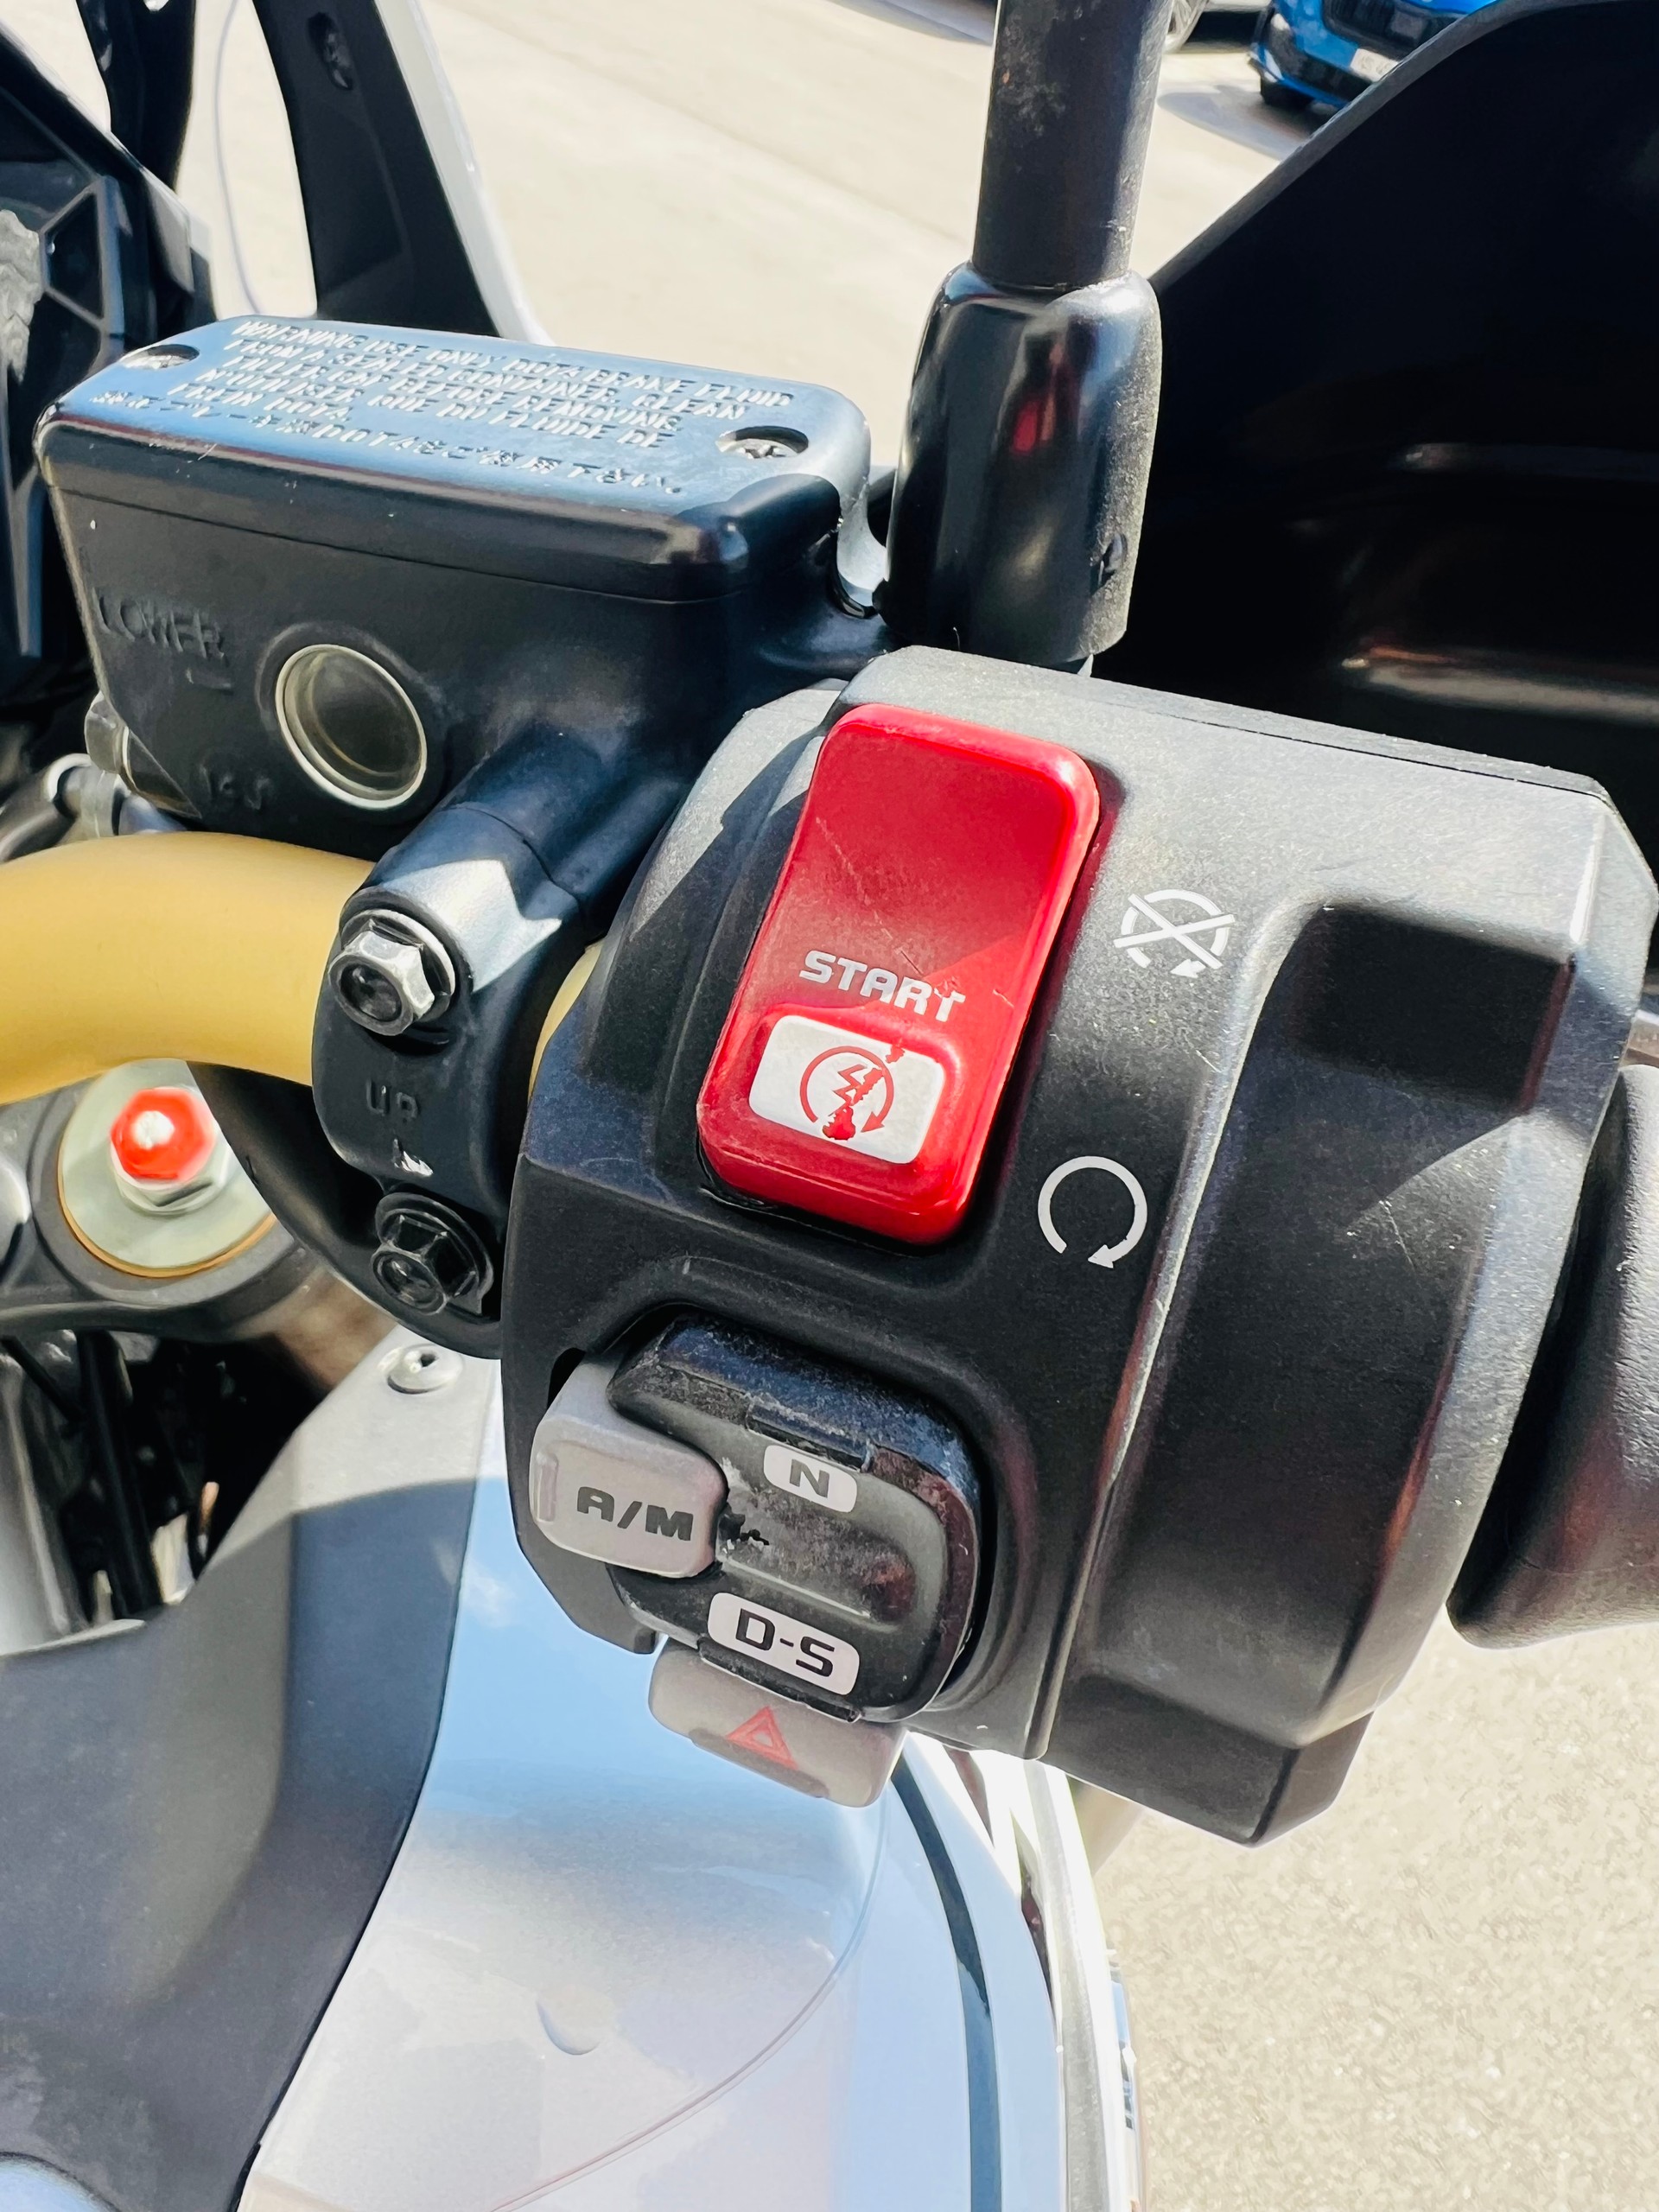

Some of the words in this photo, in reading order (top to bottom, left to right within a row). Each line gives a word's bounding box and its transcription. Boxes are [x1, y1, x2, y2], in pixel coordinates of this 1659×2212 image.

[223, 339, 305, 359] FROM
[301, 349, 329, 362] A
[328, 352, 448, 377] SEALED
[632, 393, 750, 420] CLEAN
[223, 355, 329, 379] FILLER
[327, 370, 392, 387] CAP
[388, 378, 517, 405] BEFORE
[232, 321, 368, 347] WARNING
[363, 340, 429, 357] USE
[426, 349, 507, 368] ONLY
[582, 368, 696, 393] BRAKE
[693, 383, 794, 407] FLUID
[167, 383, 264, 406] FREIN
[366, 393, 440, 412] QUE
[435, 403, 492, 420] DU
[488, 410, 617, 439] FLUIDE
[616, 429, 675, 448] DE
[91, 588, 229, 667] LOWER
[799, 950, 966, 1022] START
[366, 1079, 418, 1122] UP
[789, 1459, 830, 1498] N
[576, 1486, 694, 1541] A/M
[735, 1608, 835, 1678] D-S
